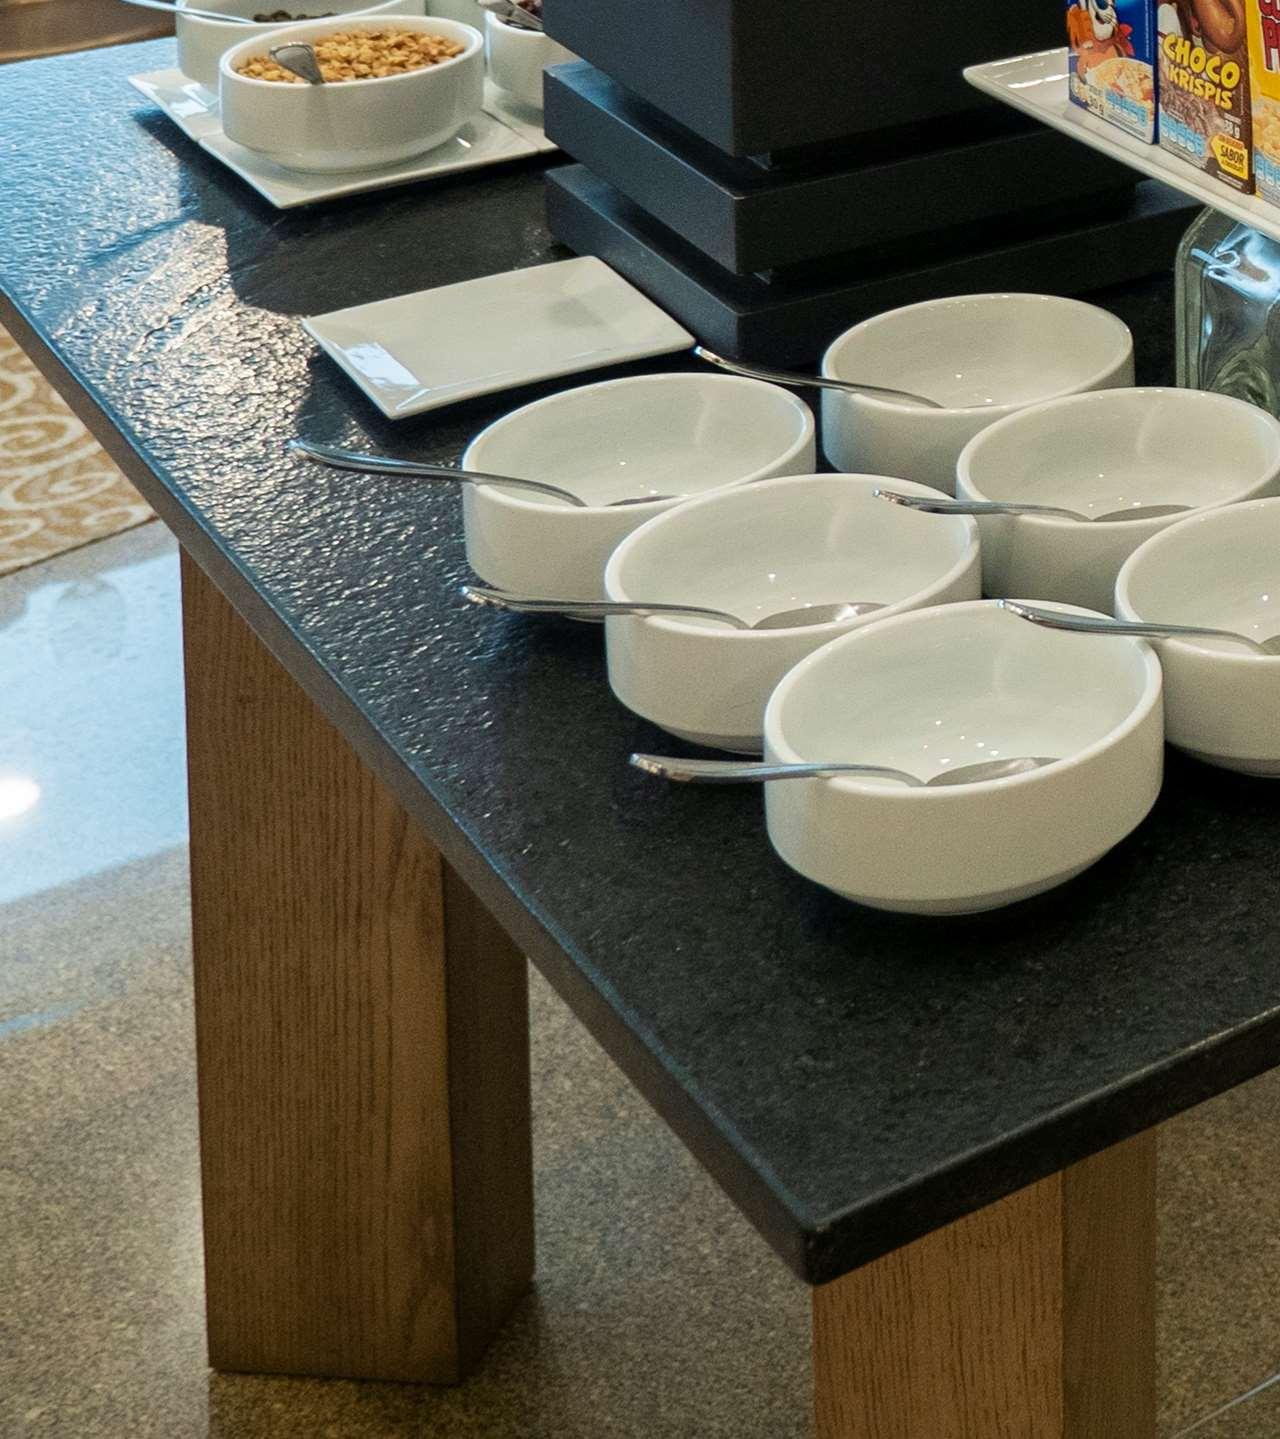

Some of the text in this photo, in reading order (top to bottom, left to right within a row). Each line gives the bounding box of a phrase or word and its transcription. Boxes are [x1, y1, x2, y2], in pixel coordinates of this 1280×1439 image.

[1162, 32, 1241, 89] CHOCO
[1167, 63, 1234, 111] KRISPIS
[1220, 144, 1246, 166] SABOR
